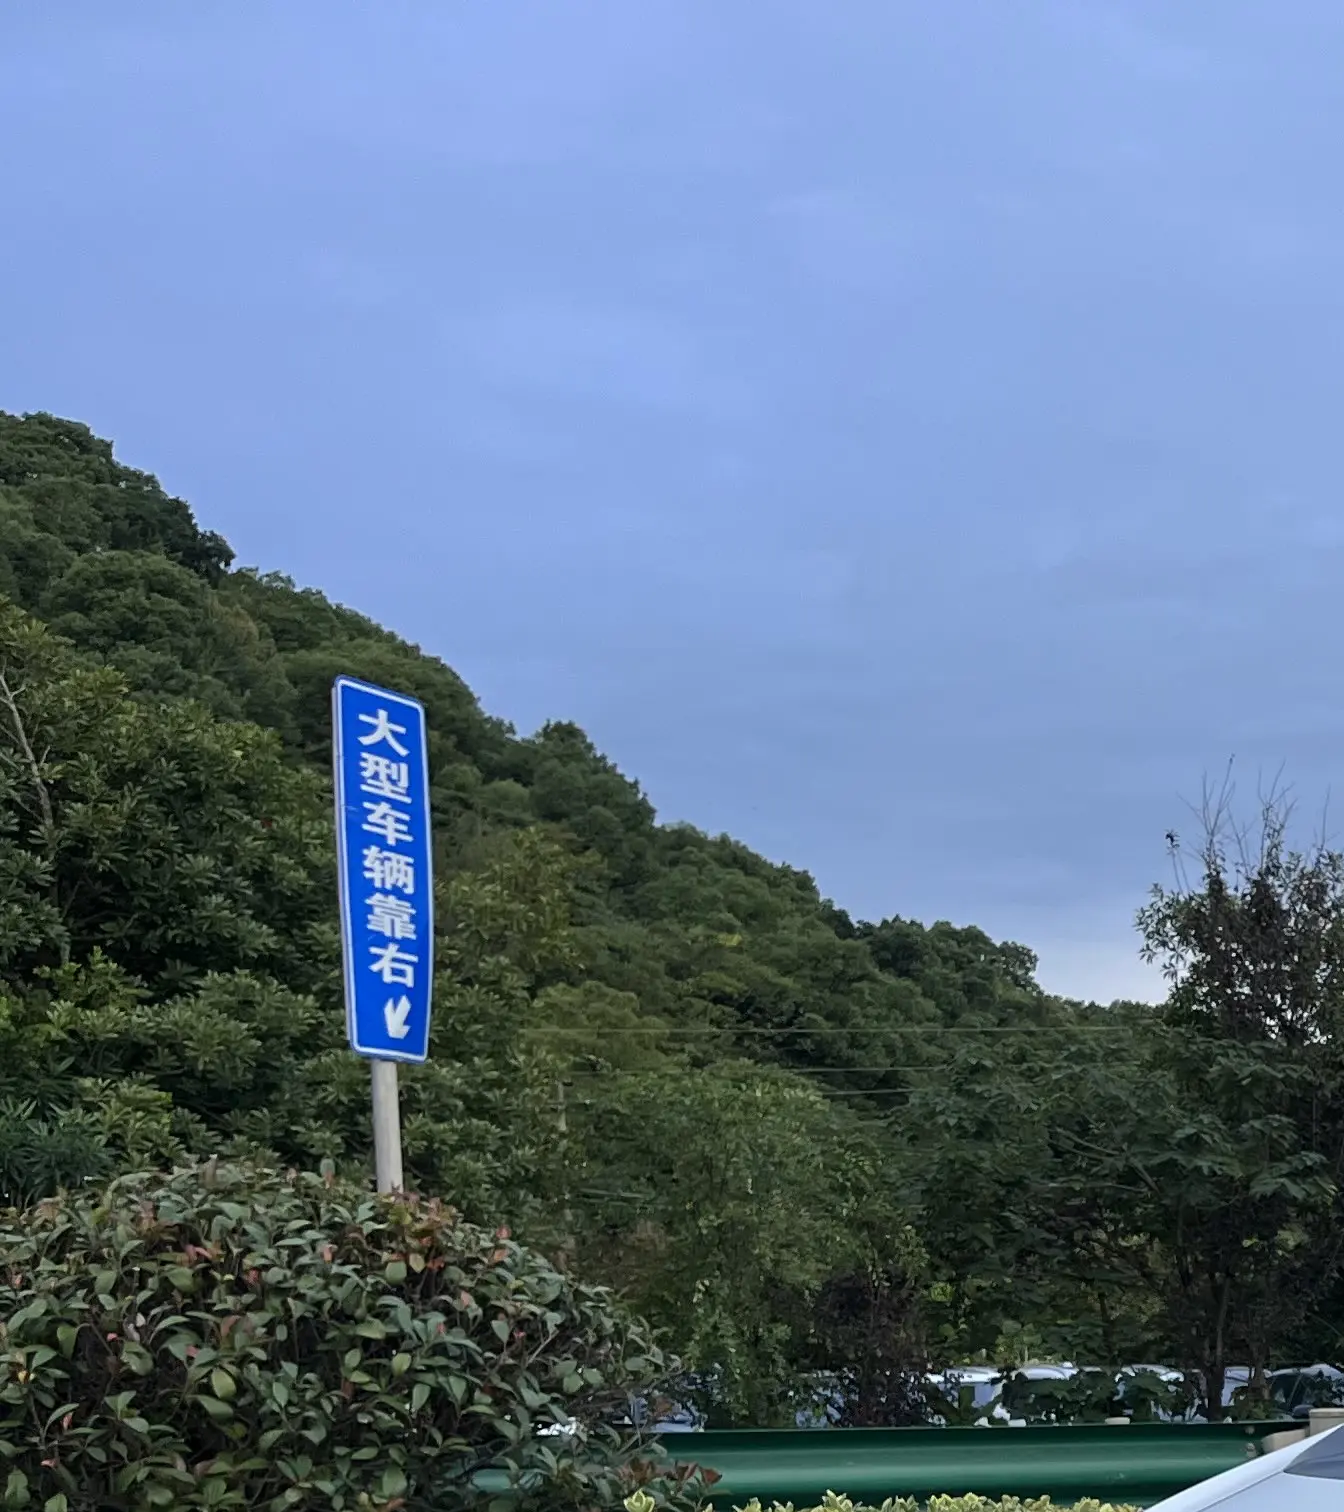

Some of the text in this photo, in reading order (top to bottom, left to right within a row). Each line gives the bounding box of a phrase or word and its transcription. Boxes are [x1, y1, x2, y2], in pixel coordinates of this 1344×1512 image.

[357, 708, 420, 989] 大型车辆靠右
